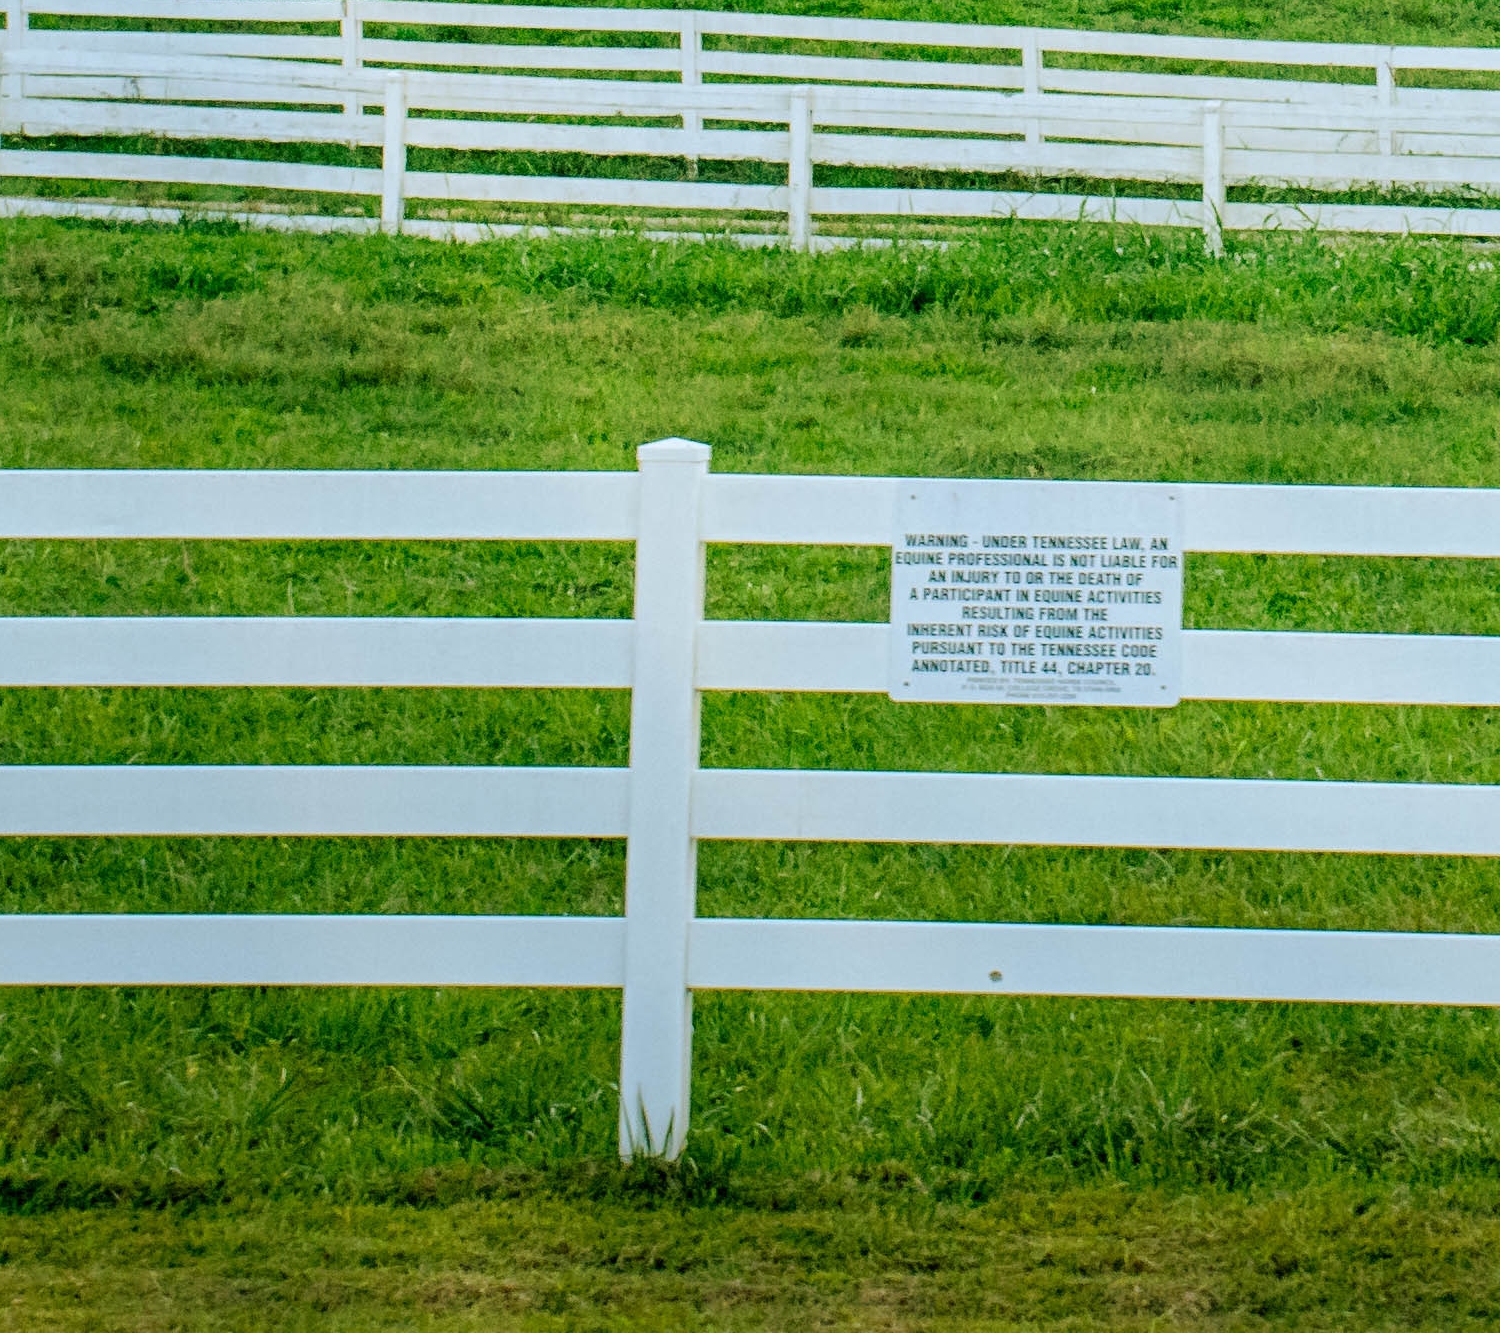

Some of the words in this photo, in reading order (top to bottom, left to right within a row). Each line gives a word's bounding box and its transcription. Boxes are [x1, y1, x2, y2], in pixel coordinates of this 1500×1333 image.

[905, 533, 968, 548] WARNING
[982, 535, 1027, 549] UNDER
[1032, 535, 1108, 550] TENNESSEE
[1113, 537, 1144, 551] LAW,
[1150, 537, 1168, 551] AN
[895, 551, 943, 566] EQUINE
[948, 552, 1048, 567] PROFESSIONAL
[1053, 553, 1065, 568] IS
[1070, 553, 1096, 568] NOT
[1101, 555, 1146, 569] LIABLE
[1151, 555, 1177, 569] FOR
[928, 569, 946, 583] AN
[951, 570, 999, 584] INJURY
[1004, 571, 1021, 585] TO
[1026, 571, 1044, 585] OR
[1048, 571, 1073, 586] THE
[1078, 572, 1121, 586] DEATH
[1126, 572, 1143, 586] OF
[909, 587, 918, 601] A
[923, 587, 1012, 602] PARTICIPANT
[1016, 588, 1030, 603] IN
[1034, 589, 1082, 604] EQUINE
[1087, 589, 1162, 605] ACTIVITIES
[962, 605, 1034, 621] RESULTING
[1039, 607, 1078, 621] FROM
[1083, 607, 1108, 622] THE
[907, 623, 972, 637] INHERENT
[978, 623, 1008, 638] RISK
[1013, 624, 1030, 638] OF
[1035, 624, 1084, 640] EQUINE
[1088, 625, 1163, 641] ACTIVITIES
[912, 641, 983, 655] PURSUANT
[988, 642, 1006, 657] TO
[1011, 642, 1035, 657] THE
[1040, 643, 1116, 658] TENNESSEE
[1121, 643, 1157, 659] CODE
[911, 659, 995, 674] ANNOTATED,
[1001, 659, 1036, 675] TITLE
[1041, 661, 1062, 676] 44,
[1067, 661, 1131, 676] CHAPTER
[1135, 662, 1156, 677] 20.
